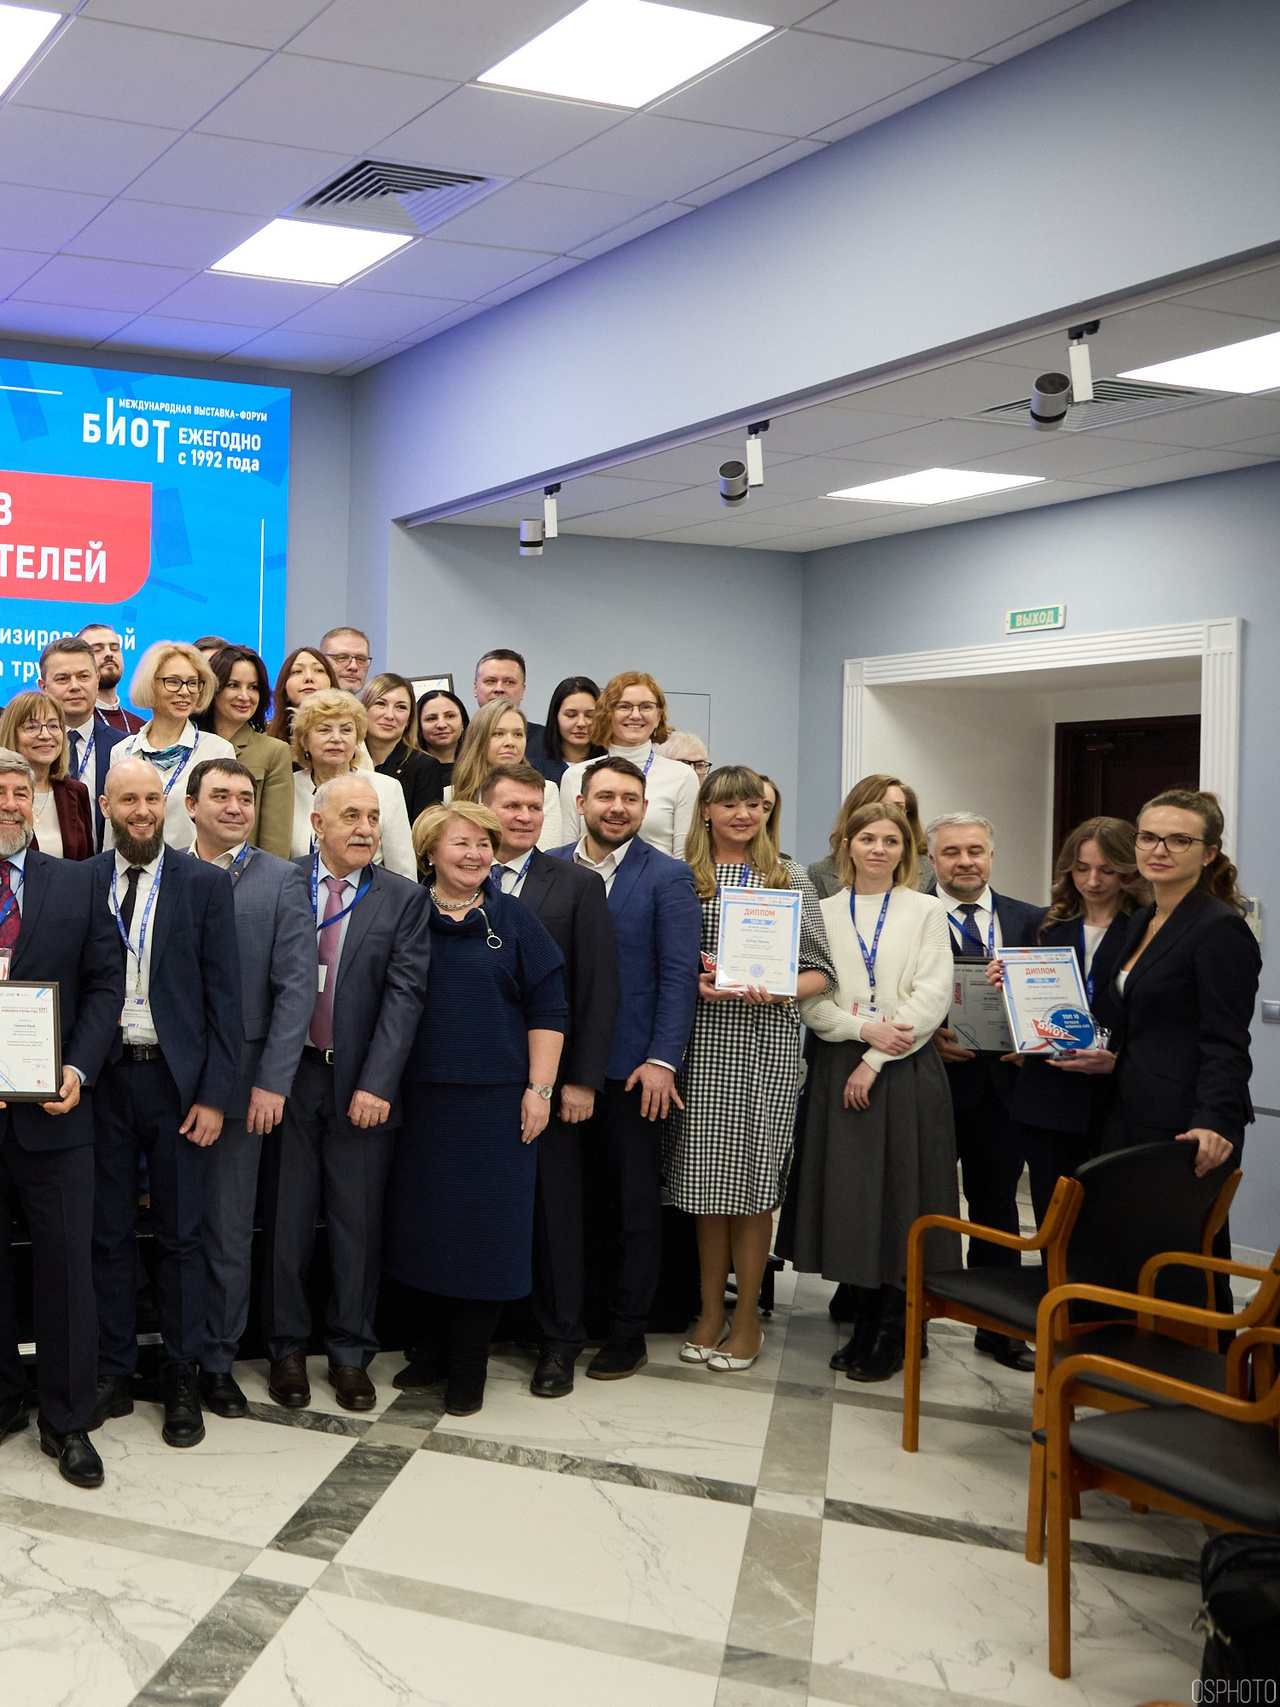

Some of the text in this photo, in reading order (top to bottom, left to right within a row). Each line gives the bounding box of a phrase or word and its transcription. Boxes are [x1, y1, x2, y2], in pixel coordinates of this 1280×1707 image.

[119, 398, 268, 422] МЕЖДУНАРОДНАЯ ВЫСТАВКА-ФОРУМ
[83, 397, 170, 463] БИОТ
[178, 427, 262, 452] ЕЖЕГОДНО
[178, 449, 260, 474] с 1992 года
[1015, 610, 1055, 627] ВЫХОД
[744, 908, 776, 917] ДИПЛОМ
[1025, 967, 1057, 976] ДИПЛОМ
[1037, 1018, 1068, 1039] БИОТ
